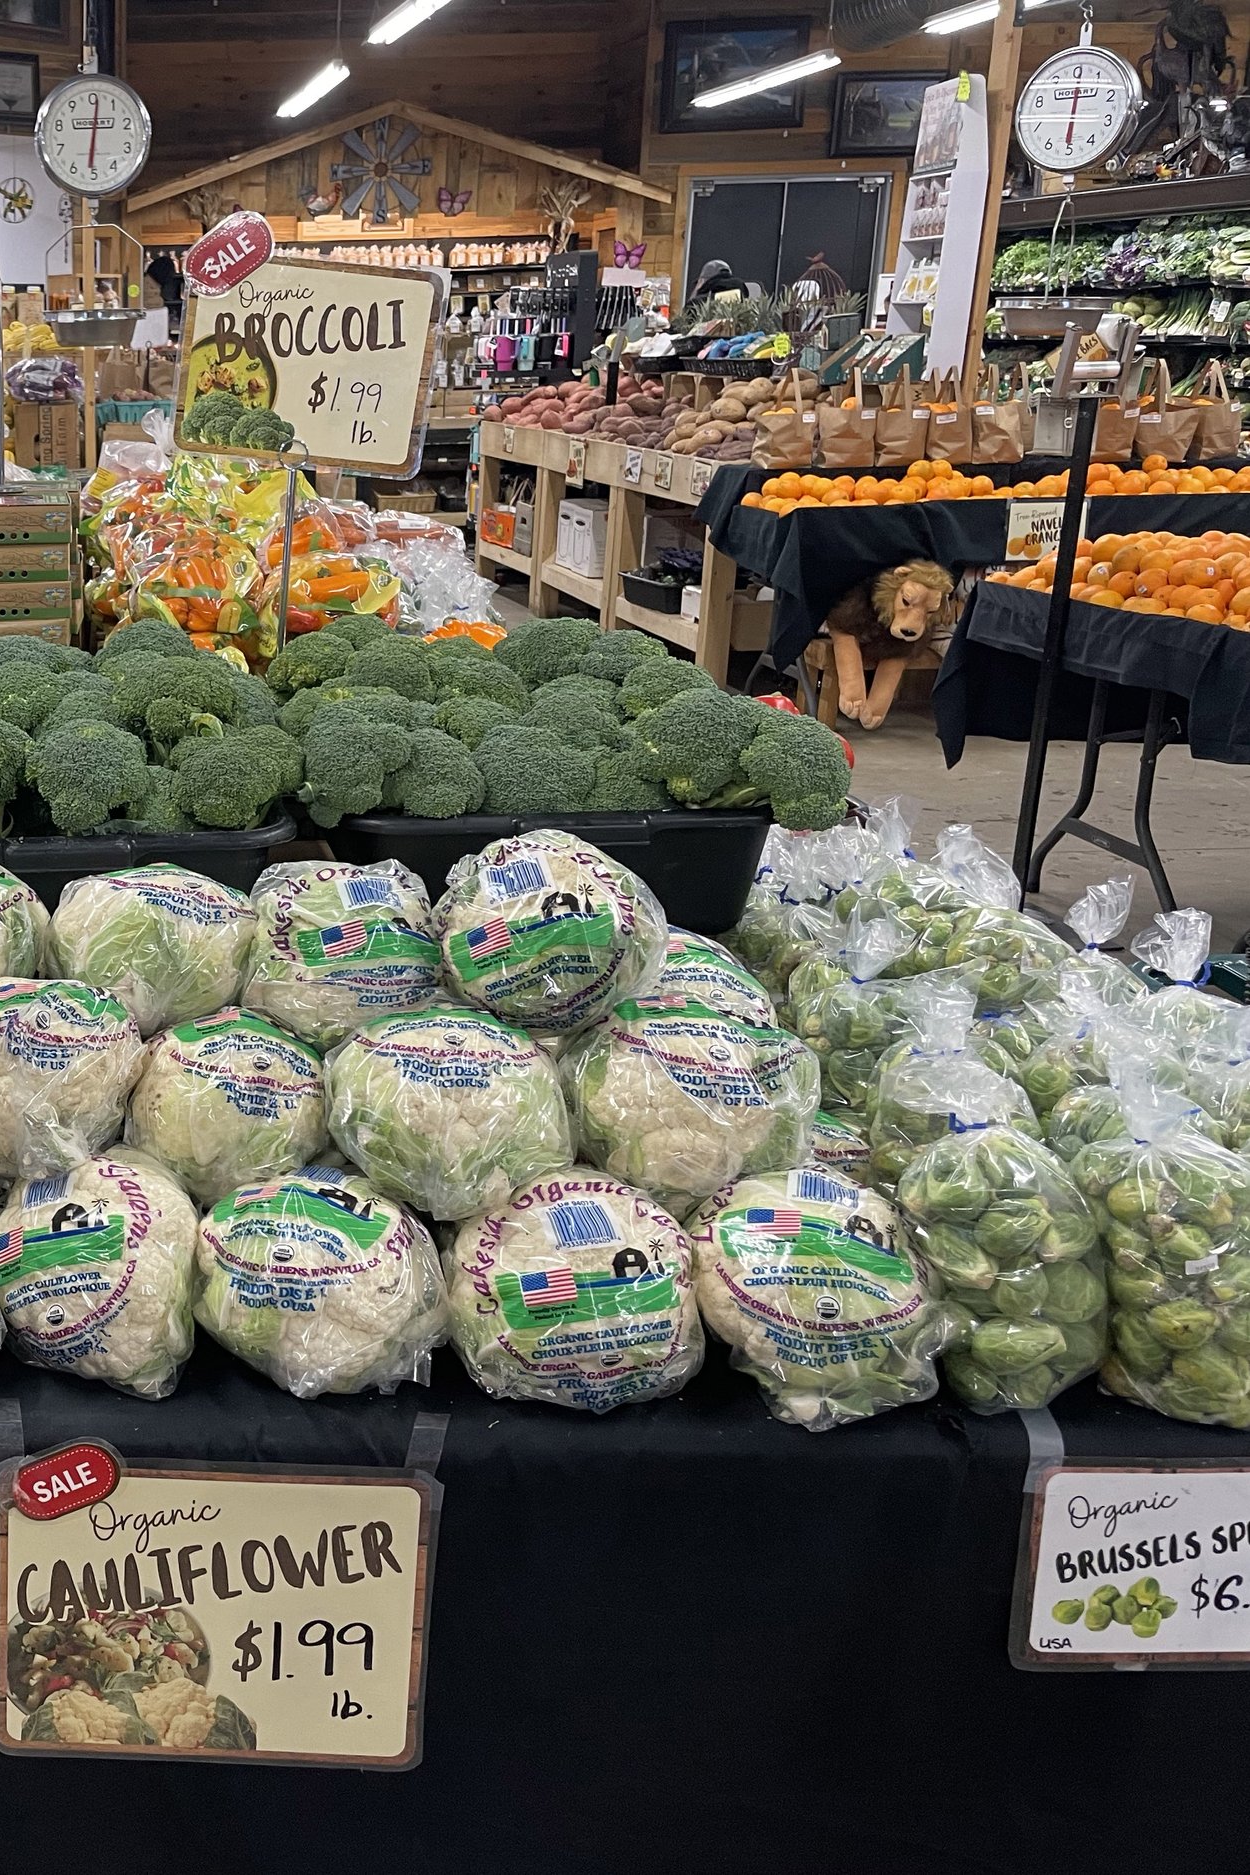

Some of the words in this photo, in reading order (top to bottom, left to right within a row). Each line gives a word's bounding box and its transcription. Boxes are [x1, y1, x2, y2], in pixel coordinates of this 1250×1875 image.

[1073, 66, 1082, 78] 0
[88, 93, 98, 105] 0
[1036, 96, 1043, 108] 8
[1106, 90, 1115, 102] 2
[69, 101, 76, 112] 9
[111, 99, 115, 111] 1
[55, 120, 63, 131] 8
[123, 118, 131, 130] 2
[1104, 115, 1112, 127] 3
[1045, 138, 1052, 150] 6
[1087, 134, 1095, 145] 4
[56, 144, 64, 156] 7
[123, 142, 131, 154] 3
[1065, 144, 1073, 155] 5
[70, 162, 77, 174] 6
[110, 160, 117, 172] 4
[90, 169, 98, 180] 5
[376, 209, 385, 223] S
[200, 232, 257, 279] SALE
[238, 280, 314, 318] Organic
[214, 300, 406, 362] BROCCOLI
[308, 371, 382, 414] $1.99
[351, 420, 377, 444] lb.
[1025, 530, 1060, 545] ORANG
[145, 897, 192, 919] PRODUCE
[485, 966, 530, 992] ORGANIC
[722, 1084, 751, 1096] DES
[724, 1096, 742, 1107] OF
[511, 1181, 634, 1211] Organic
[126, 1259, 137, 1275] CA
[743, 1276, 827, 1288] CHOUX-FLEUR
[714, 1262, 752, 1305] LAKESIDE
[751, 1300, 803, 1328] ORGANIC
[803, 1319, 863, 1332] GARDENS,
[538, 1333, 594, 1348] ORGANIC
[828, 1340, 859, 1351] DES
[531, 1341, 614, 1360] CHOUX-FLEUR
[829, 1354, 849, 1365] OF
[851, 1350, 879, 1361] USA
[32, 1461, 98, 1503] SALE
[1068, 1492, 1179, 1538] Organic
[89, 1500, 222, 1552] Organic
[1055, 1531, 1201, 1583] BRUSSELS
[17, 1520, 403, 1625] CAULIFLOWER
[231, 1619, 375, 1681] $1.99
[1039, 1638, 1072, 1649] USA
[331, 1691, 373, 1720] lb.
